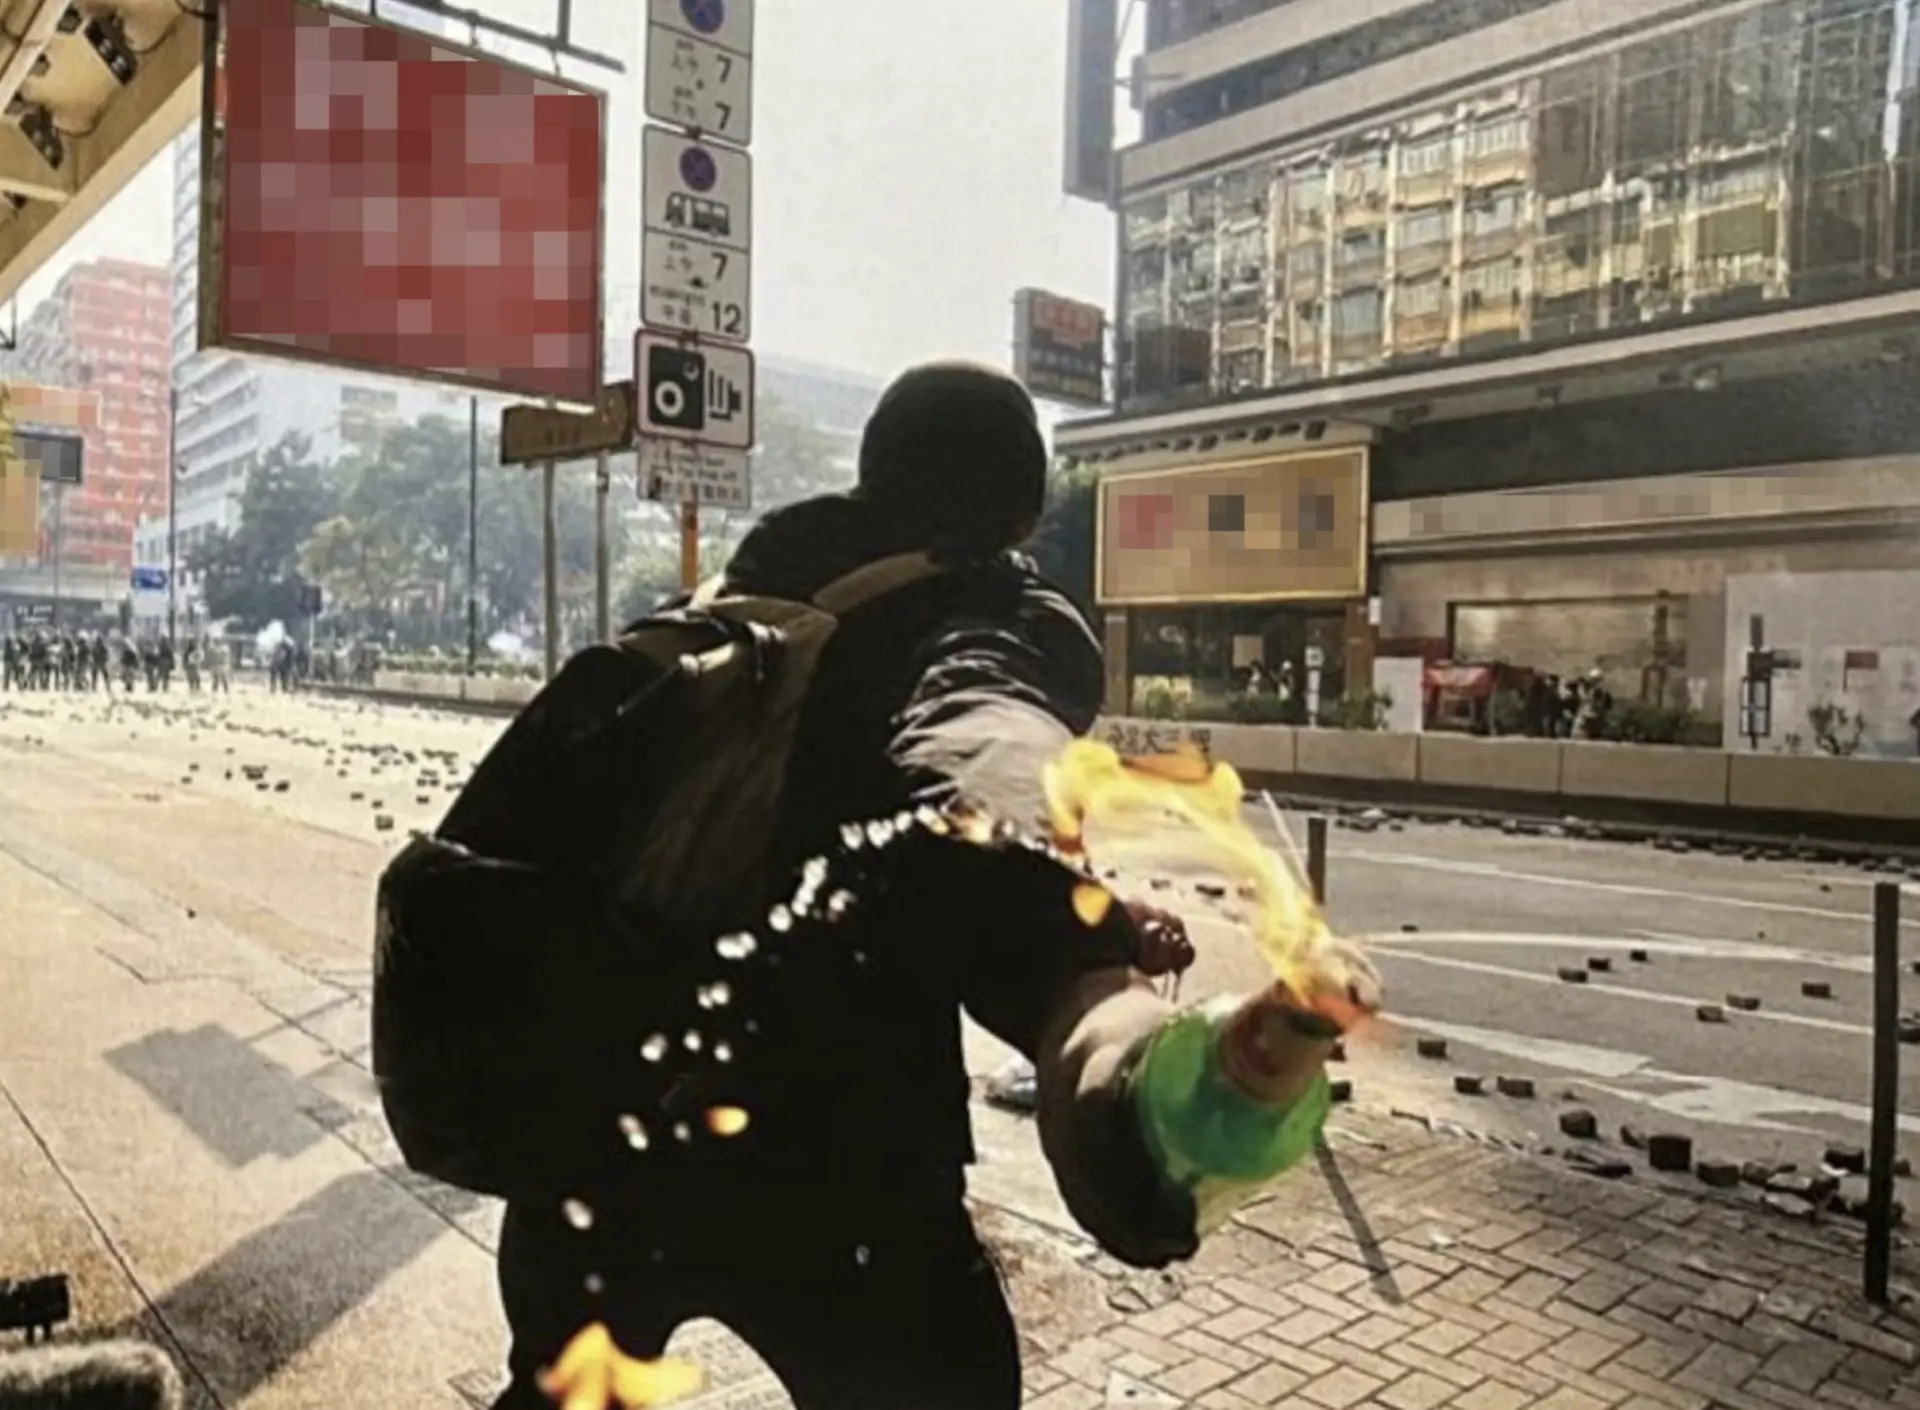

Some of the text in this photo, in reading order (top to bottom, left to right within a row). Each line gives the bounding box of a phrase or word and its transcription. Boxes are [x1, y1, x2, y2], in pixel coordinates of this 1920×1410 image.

[716, 53, 732, 84] 7
[714, 99, 732, 131] 7
[711, 252, 728, 281] 7
[712, 301, 742, 334] 12
